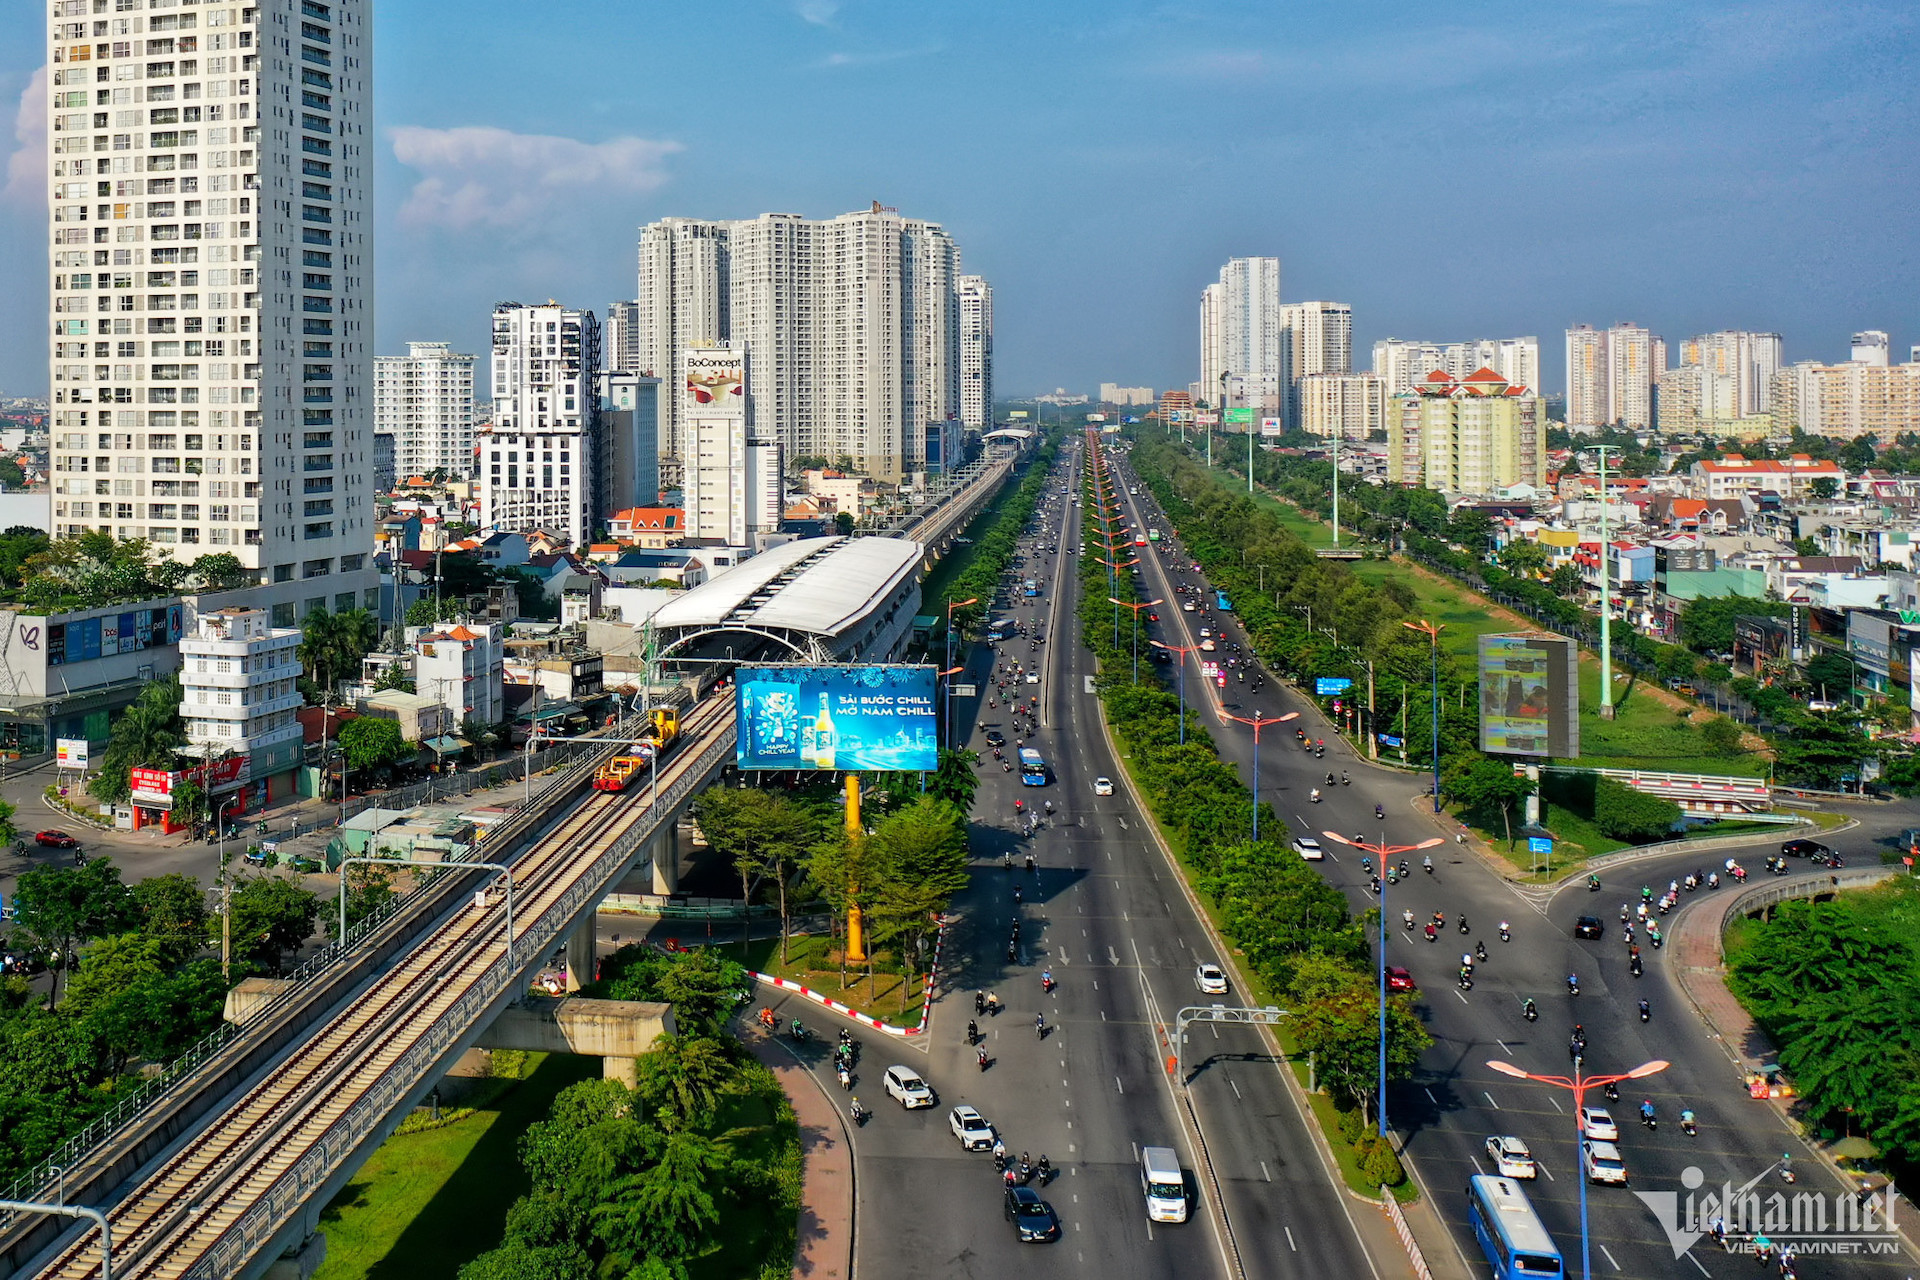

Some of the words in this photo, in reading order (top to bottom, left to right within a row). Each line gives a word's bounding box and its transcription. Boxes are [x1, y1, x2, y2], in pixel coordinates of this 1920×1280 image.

[687, 357, 741, 369] BoConcept
[860, 694, 894, 704] BƯỚC
[896, 696, 931, 704] CHILL
[896, 707, 936, 715] CHILL
